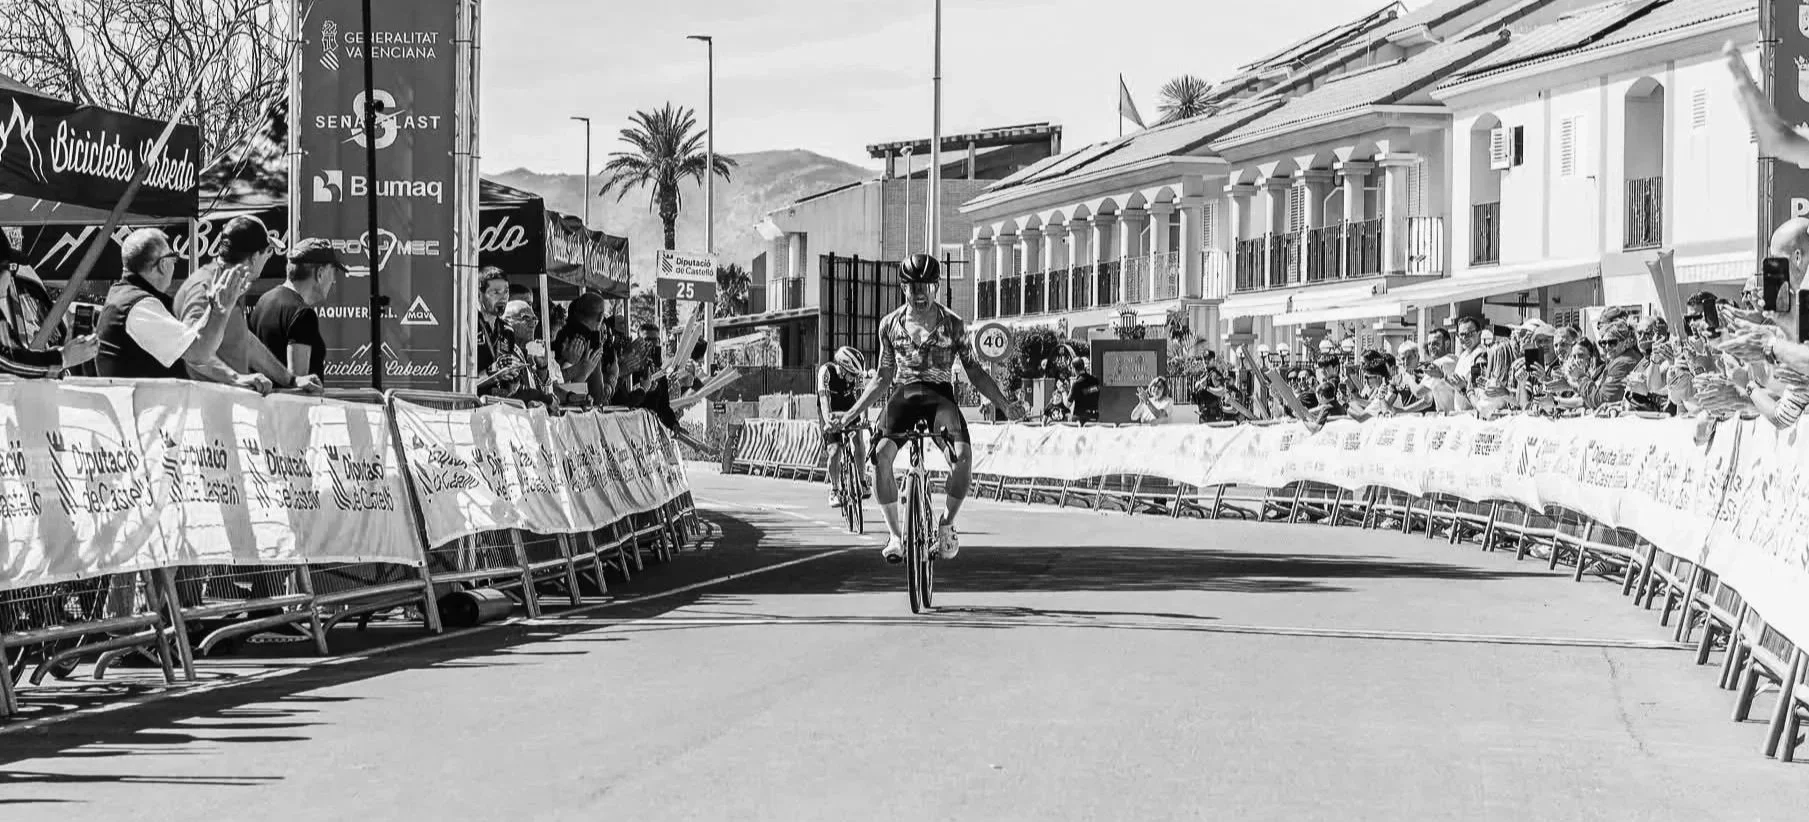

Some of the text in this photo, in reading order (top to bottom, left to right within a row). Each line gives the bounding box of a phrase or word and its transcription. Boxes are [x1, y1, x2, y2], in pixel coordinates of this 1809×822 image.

[345, 46, 437, 59] VAENCIANA
[50, 119, 135, 182] Bicicletes
[350, 175, 442, 204] Bumaq
[676, 257, 711, 268] Diputació
[675, 267, 714, 277] de Castelló
[676, 281, 695, 299] 25
[983, 335, 1004, 348] 40
[323, 360, 440, 377] iciclete Cabedo
